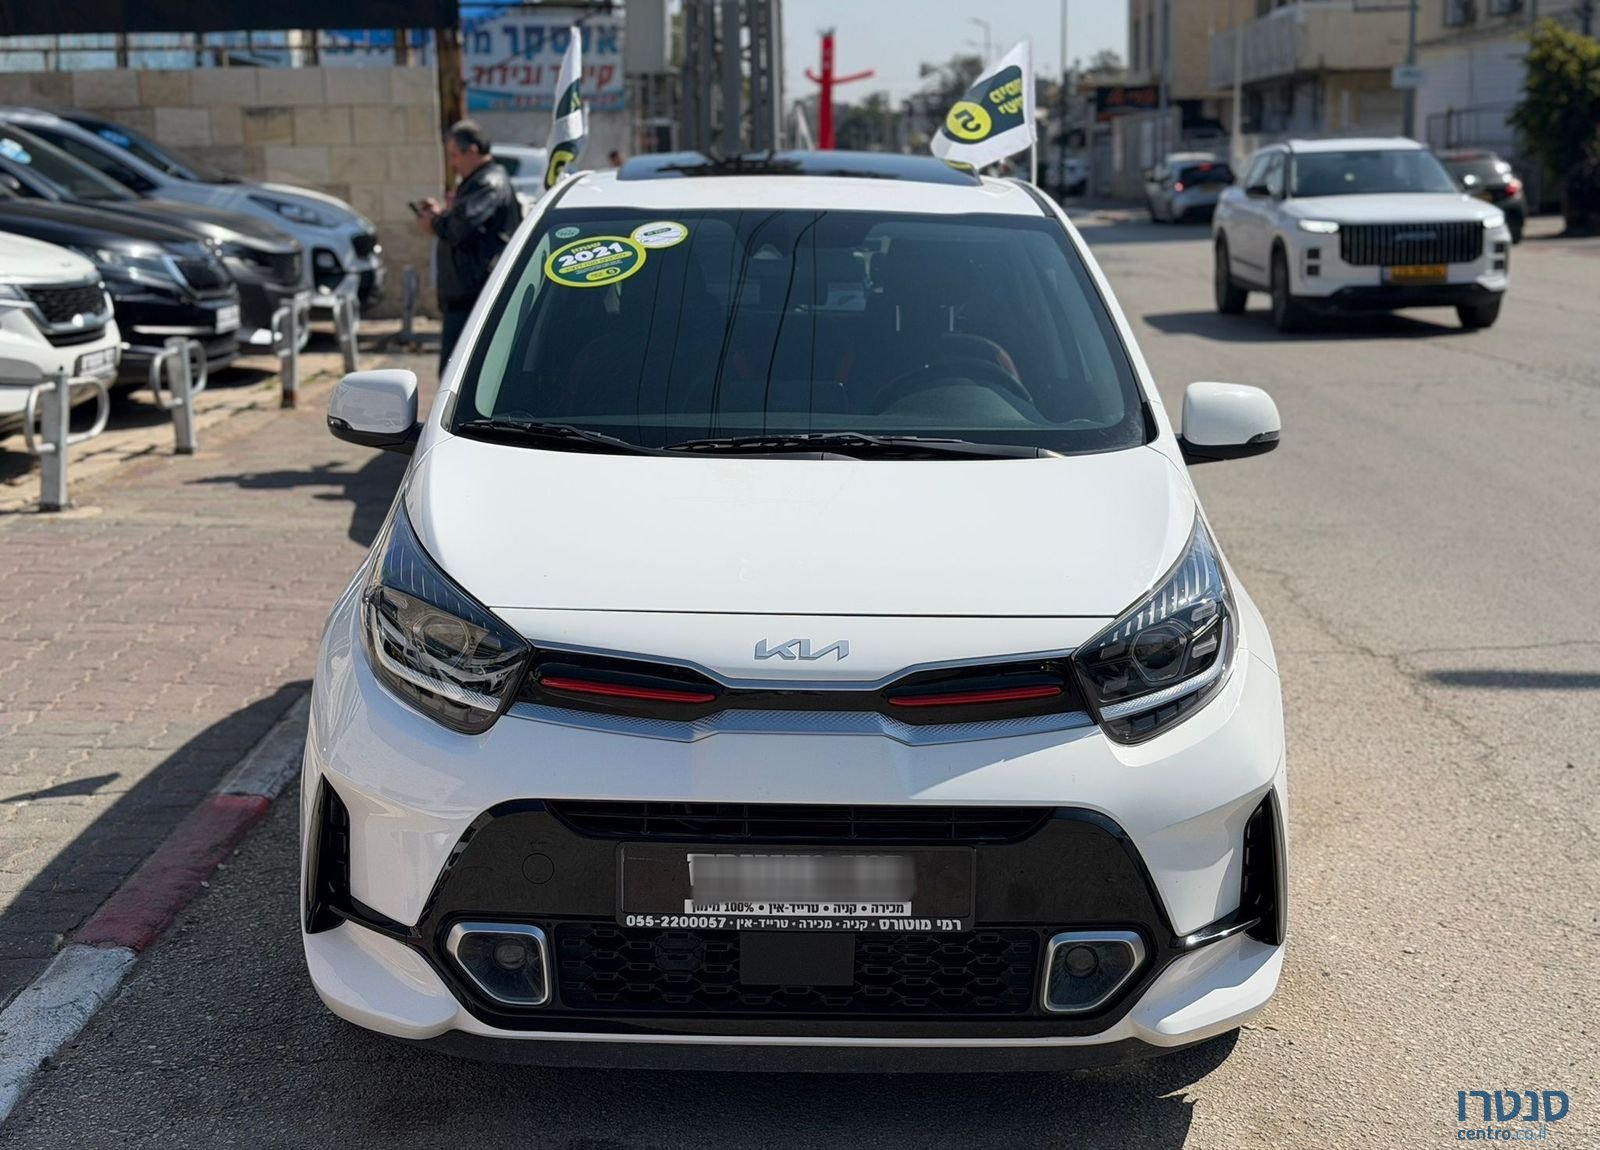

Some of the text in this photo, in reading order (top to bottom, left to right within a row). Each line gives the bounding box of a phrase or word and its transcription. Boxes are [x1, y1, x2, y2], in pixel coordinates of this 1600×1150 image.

[558, 242, 625, 268] 2021
[754, 638, 849, 661] KIA
[724, 902, 754, 913] 100%
[768, 902, 820, 914] טרייד-אין
[833, 903, 857, 915] קניה
[871, 903, 904, 914] מכירה
[626, 914, 962, 931] רמי מוטורס קניה מכירה טרייד-אין 055-2200057
